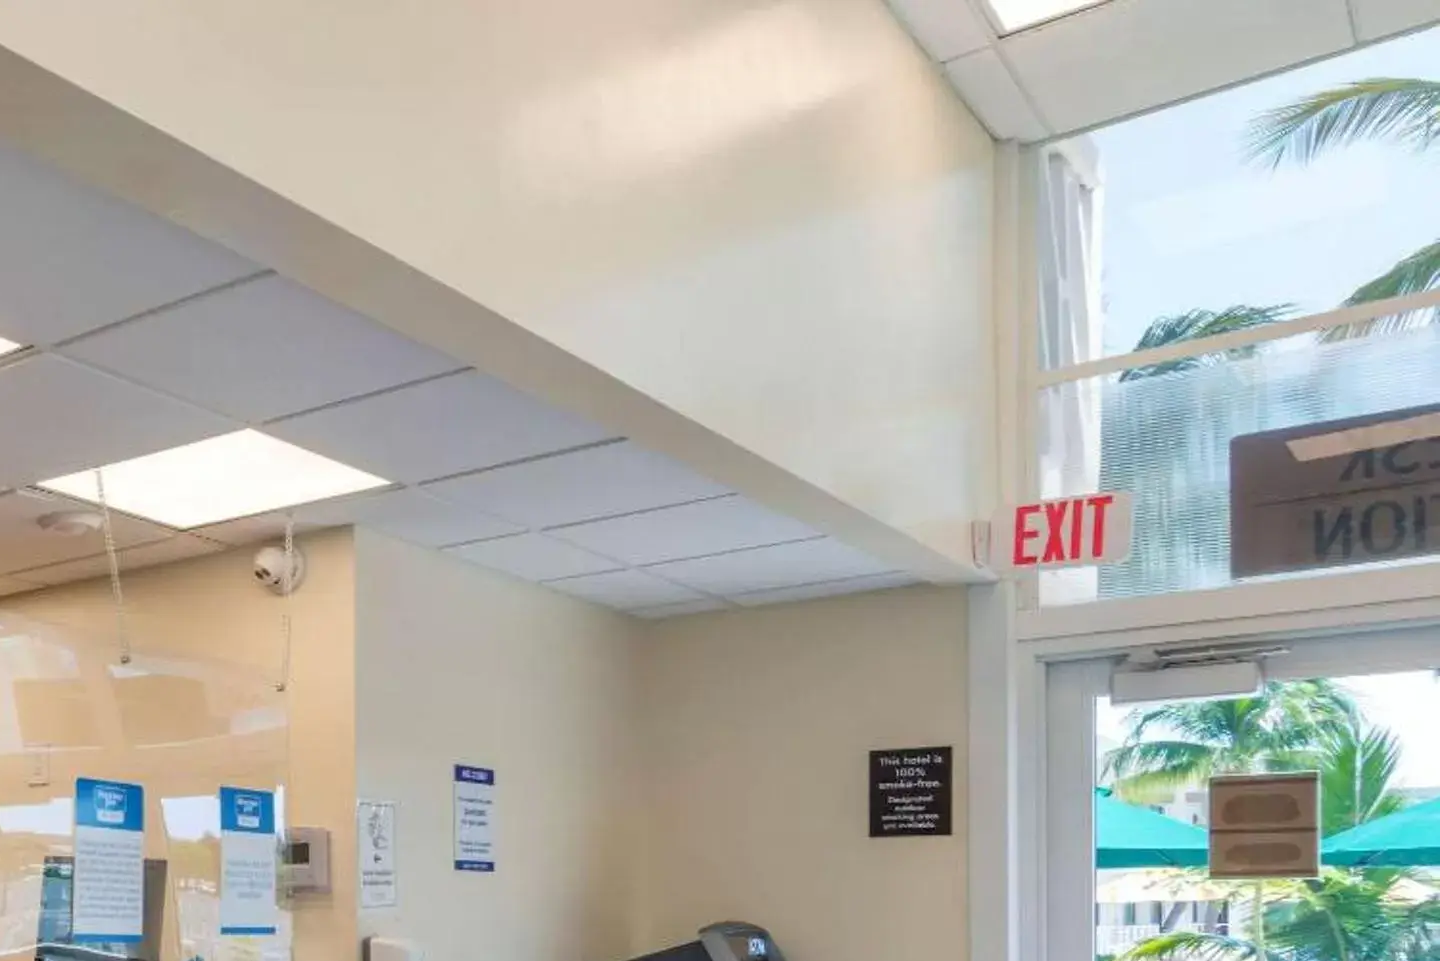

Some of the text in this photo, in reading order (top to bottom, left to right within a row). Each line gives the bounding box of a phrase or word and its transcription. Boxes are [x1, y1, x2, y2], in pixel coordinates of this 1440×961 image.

[1013, 495, 1113, 565] EXIT
[880, 754, 943, 767] This hotel is
[895, 767, 926, 777] 100%
